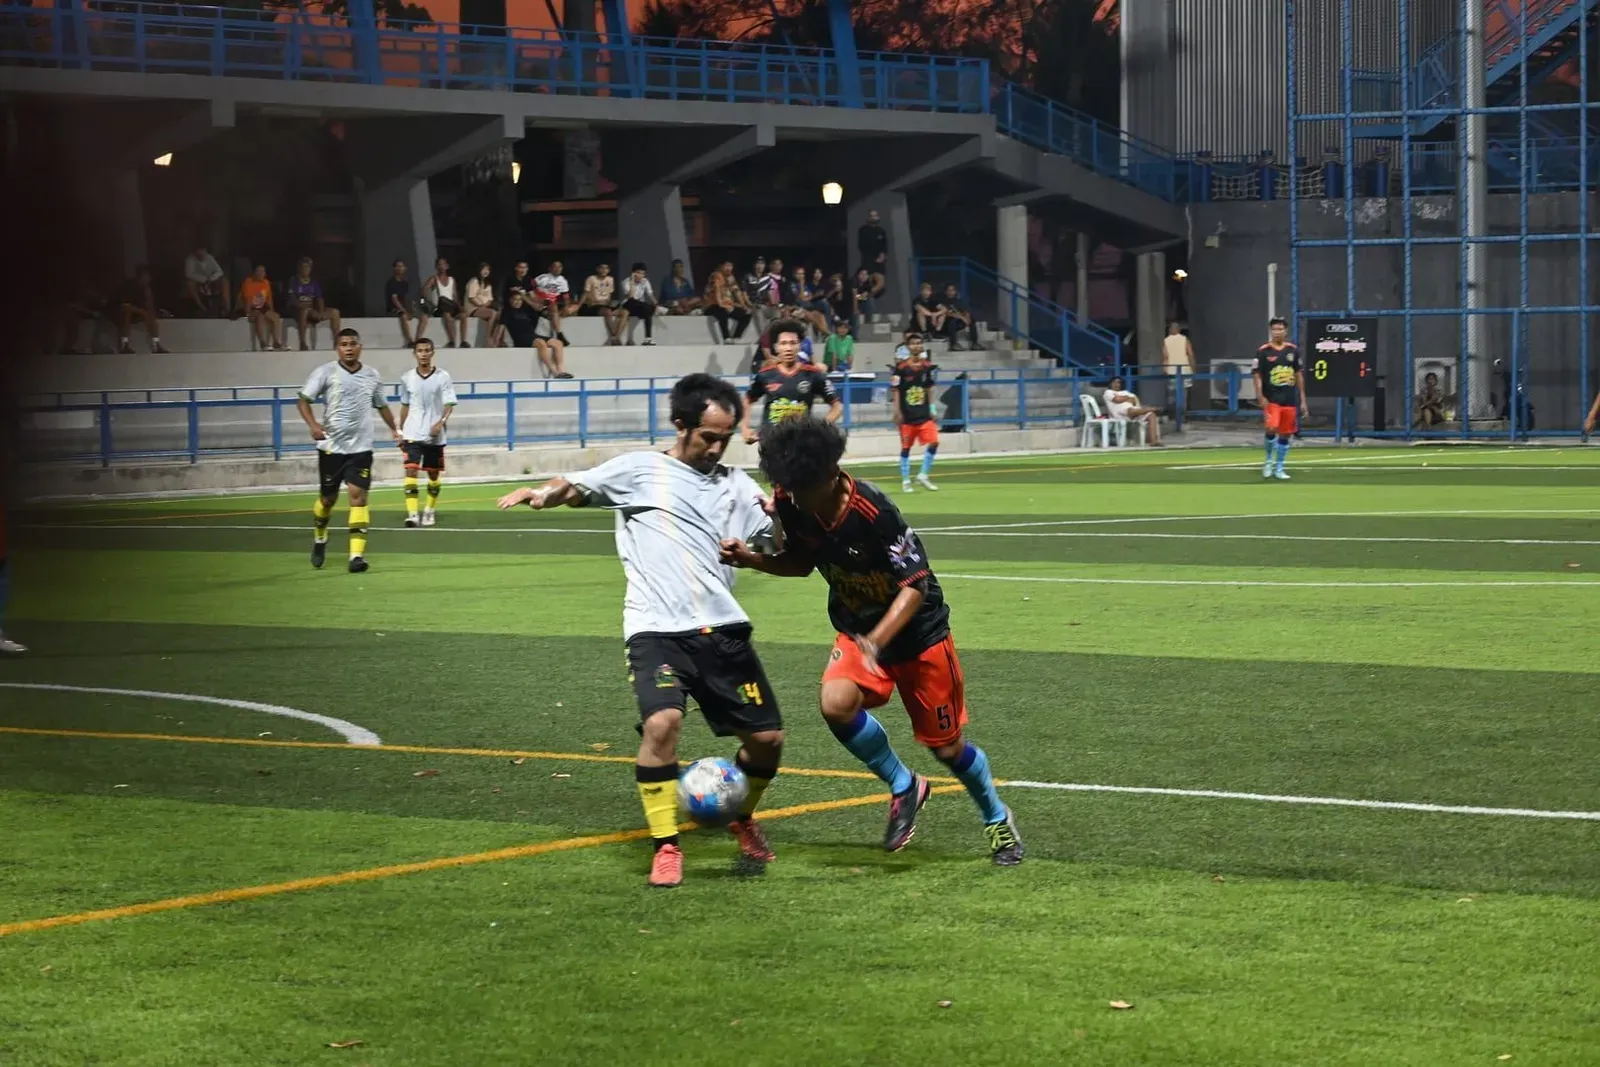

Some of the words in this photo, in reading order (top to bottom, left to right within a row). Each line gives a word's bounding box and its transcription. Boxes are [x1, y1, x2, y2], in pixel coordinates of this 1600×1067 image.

[1315, 360, 1328, 380] 0
[1360, 362, 1366, 377] 1
[736, 682, 763, 706] 14
[936, 704, 951, 730] 5
